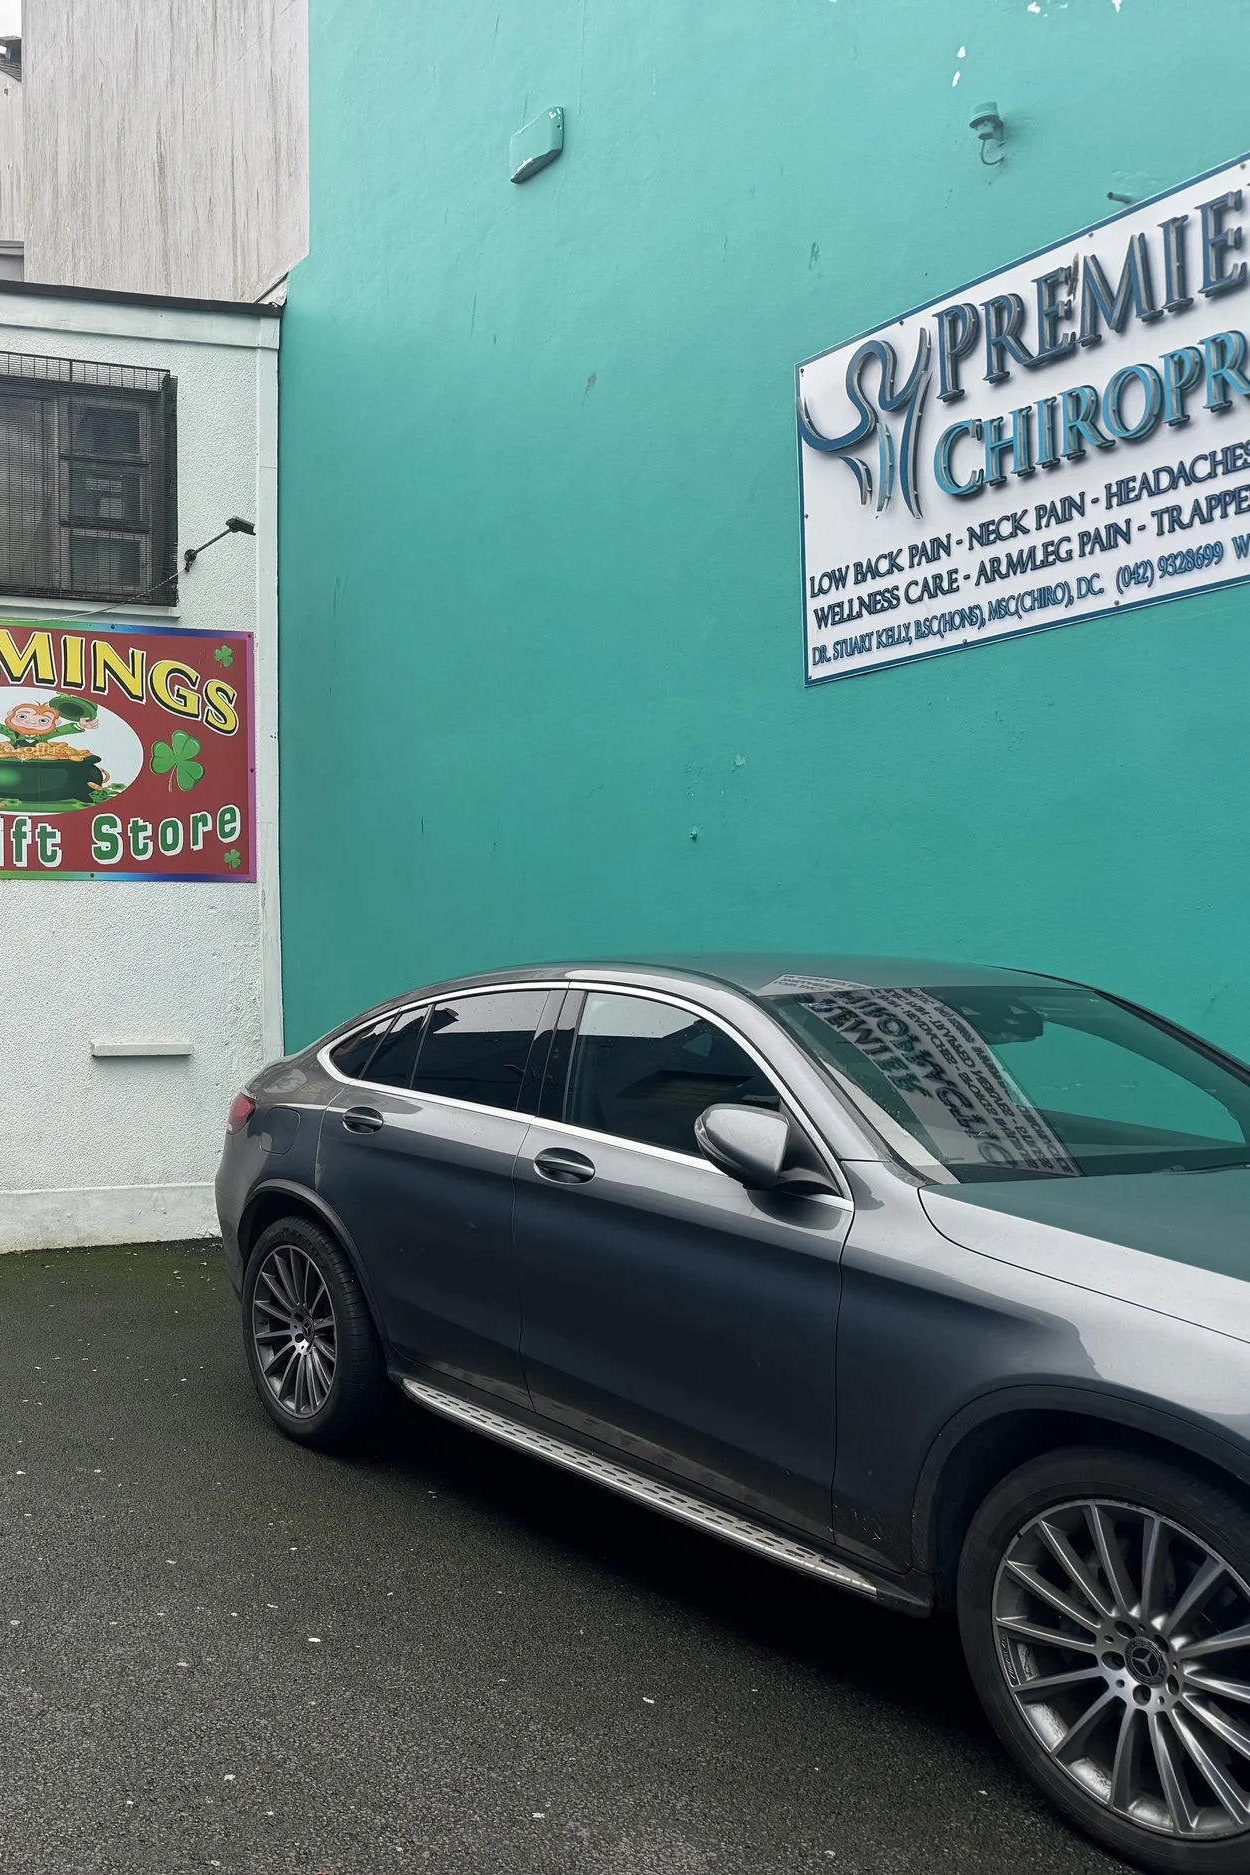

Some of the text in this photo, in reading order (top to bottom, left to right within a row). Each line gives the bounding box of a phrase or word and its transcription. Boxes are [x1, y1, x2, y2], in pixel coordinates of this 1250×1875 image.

[932, 182, 1250, 402] PREMIE
[810, 565, 850, 598] LOW
[853, 548, 905, 584] BACK
[908, 533, 951, 568] PAIN
[967, 509, 1029, 550] NECK
[1035, 491, 1085, 530] PAIN
[814, 585, 900, 629] WELLNESS
[904, 568, 959, 604] CARE
[1078, 518, 1132, 557] PAIN
[812, 644, 832, 665] DR.
[833, 631, 875, 660] STUART
[876, 621, 913, 650] KELLY,
[1116, 559, 1155, 594] (042)
[1157, 541, 1224, 579] 9328699
[91, 803, 241, 865] Store
